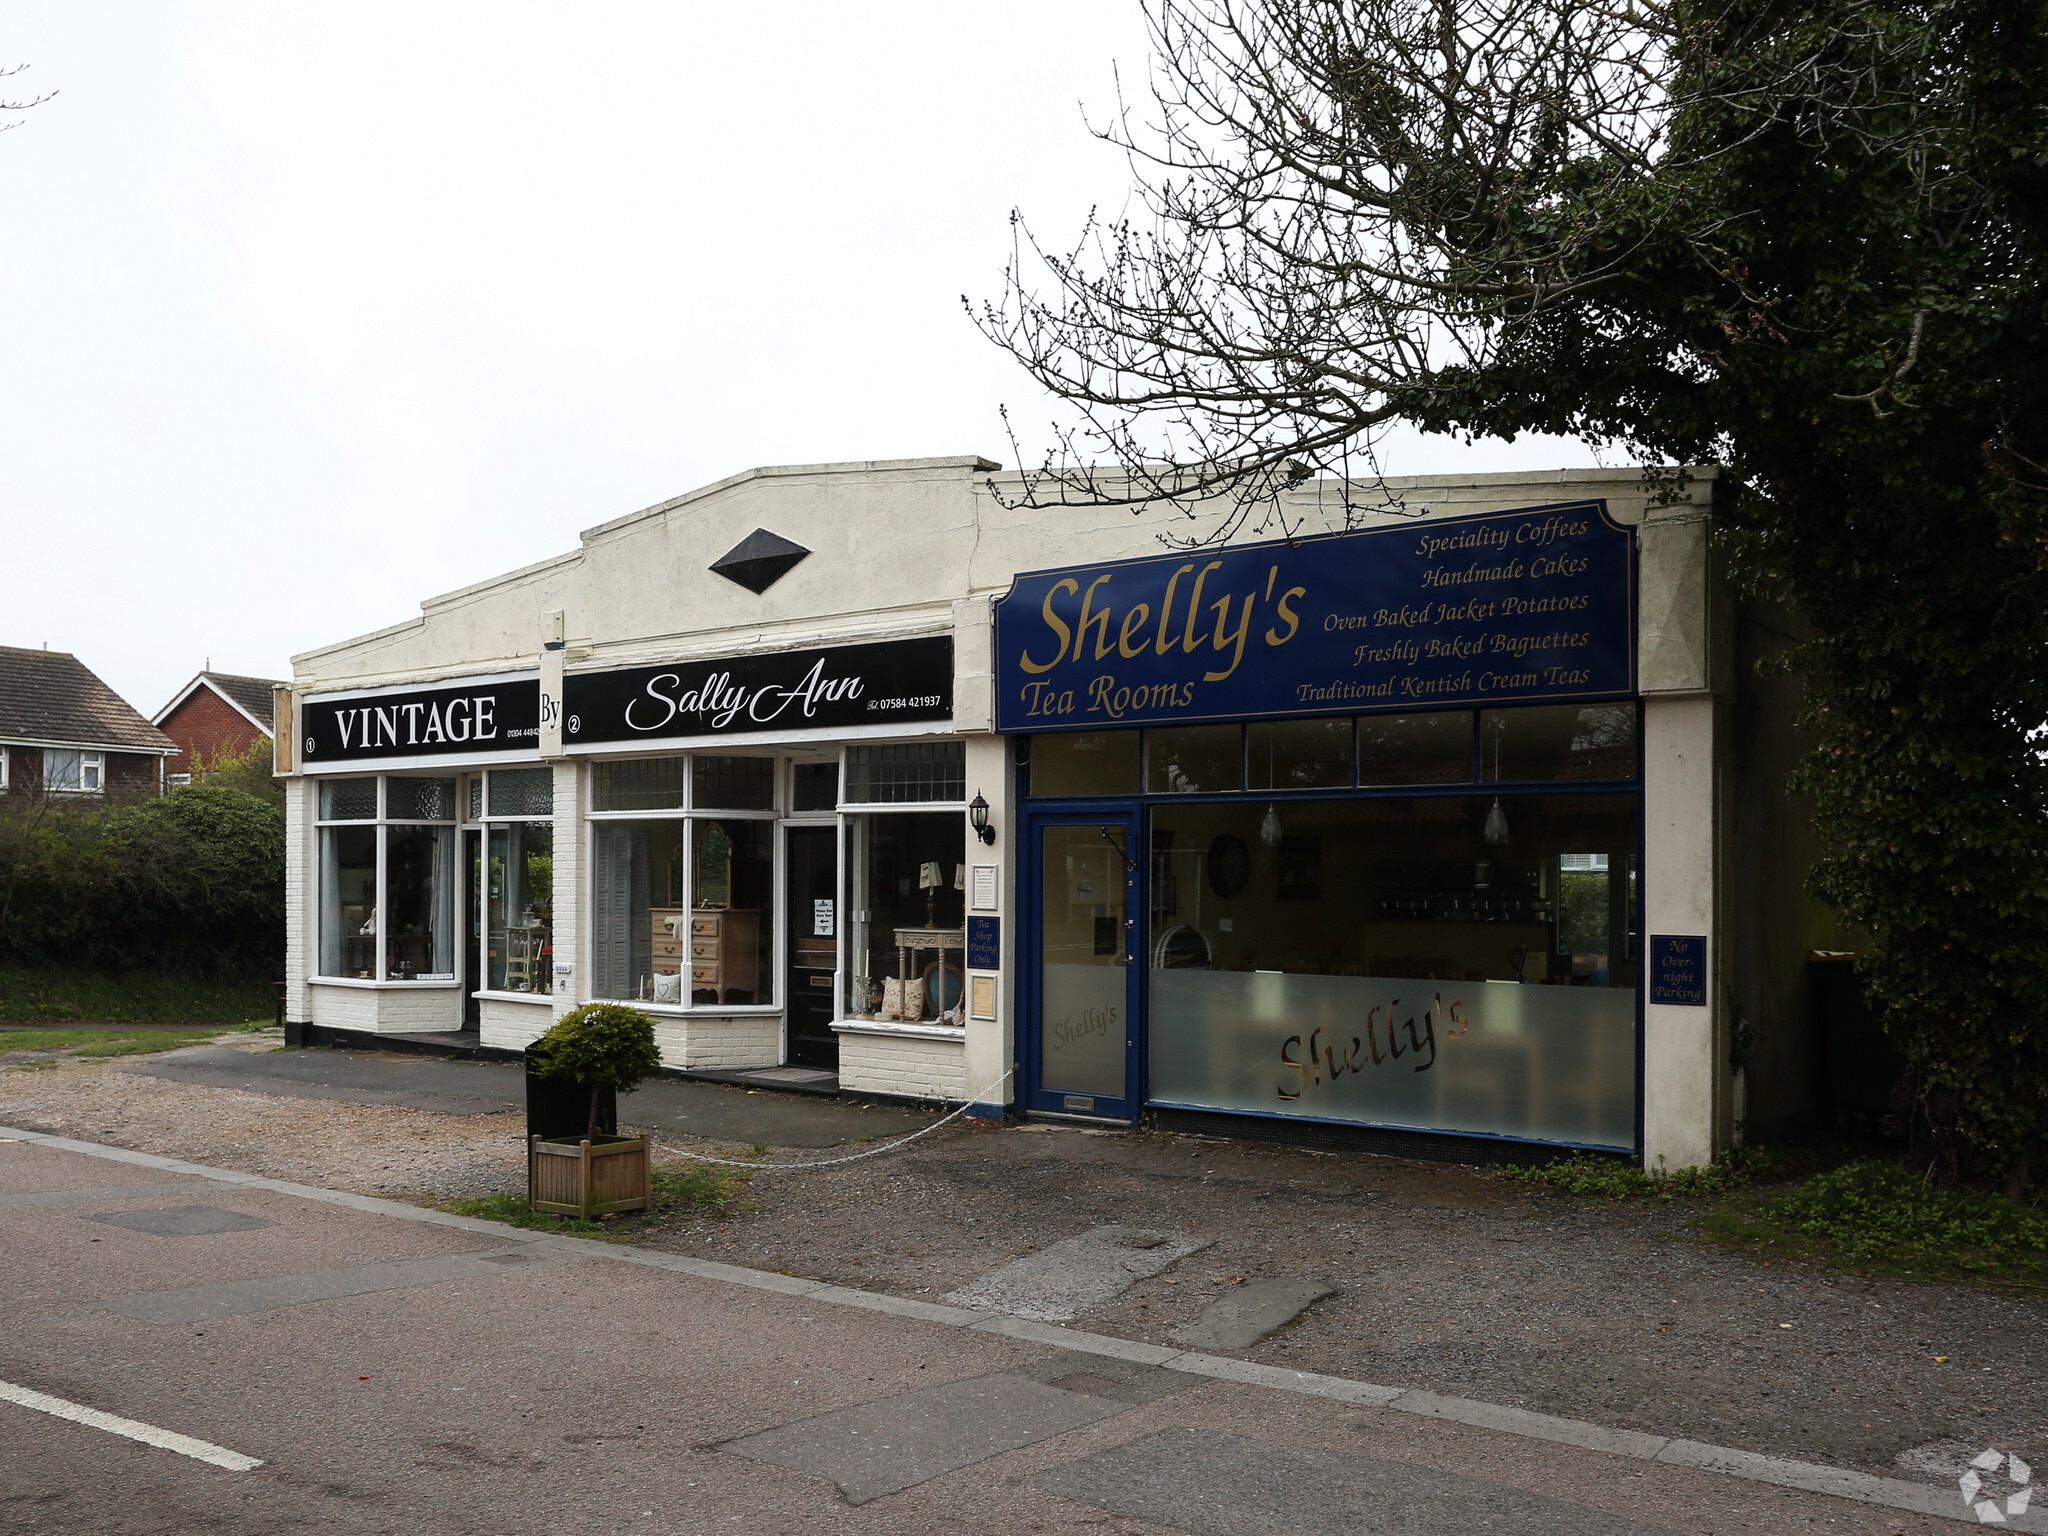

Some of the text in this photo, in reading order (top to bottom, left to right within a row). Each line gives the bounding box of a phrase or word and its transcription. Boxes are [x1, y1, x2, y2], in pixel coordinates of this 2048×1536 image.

[1415, 516, 1588, 559] Speciality Coffees
[1421, 553, 1589, 588] Handmade Cakes
[1018, 560, 1307, 682] Shelly's
[1323, 594, 1589, 632] Oven Baked Jacket Potatoes
[1353, 631, 1590, 666] Freshly Baked Baguettes
[625, 657, 865, 731] Sally Ann
[1020, 674, 1195, 718] Tea Rooms
[1296, 666, 1590, 701] Traditional Kentish Cream Teas
[541, 693, 561, 730] By
[880, 698, 907, 710] 07584
[908, 695, 941, 708] 421937
[334, 696, 498, 749] VINTAGE
[974, 931, 993, 942] Shop
[976, 919, 990, 928] Tea
[969, 942, 997, 955] Parking
[974, 954, 991, 966] Only
[1662, 955, 1695, 967] Over-
[1669, 939, 1688, 954] No
[1655, 985, 1702, 1002] Parking
[1663, 970, 1695, 986] night
[1053, 1003, 1117, 1051] Shelly's
[1276, 992, 1470, 1101] Shelly's
